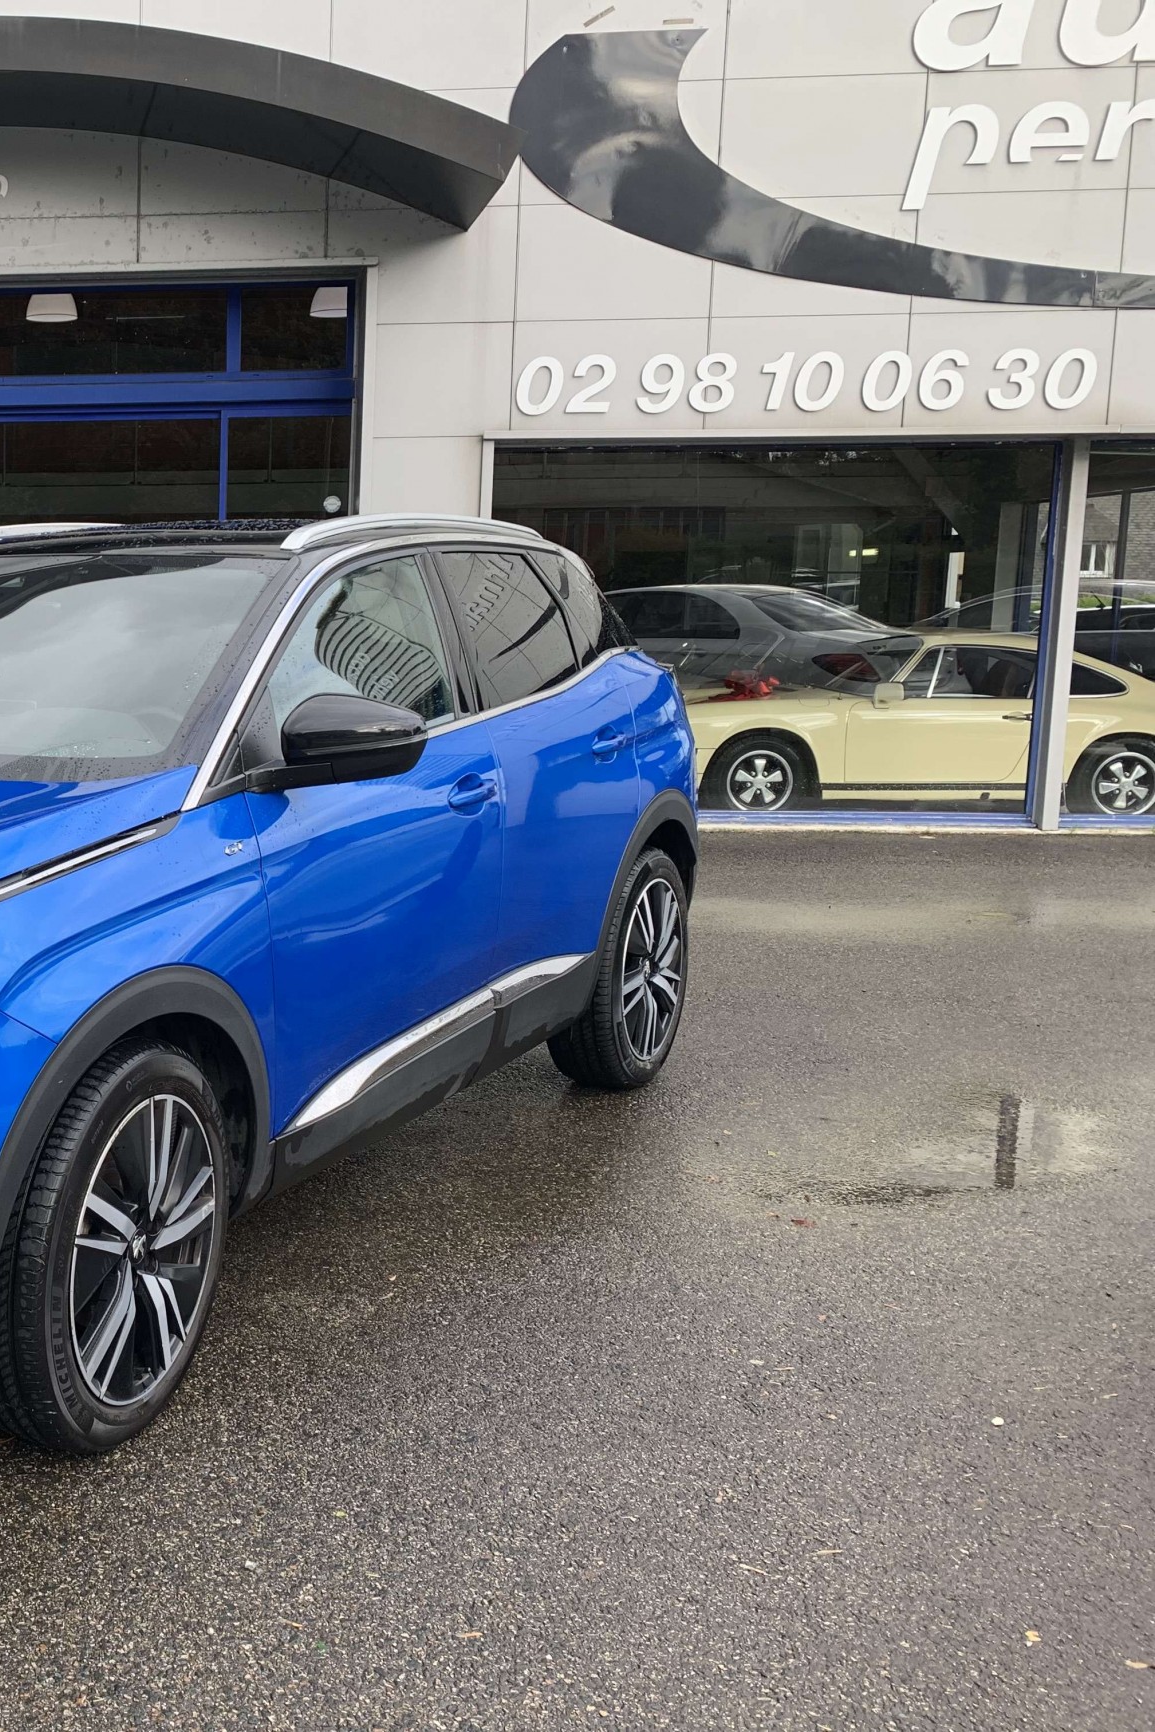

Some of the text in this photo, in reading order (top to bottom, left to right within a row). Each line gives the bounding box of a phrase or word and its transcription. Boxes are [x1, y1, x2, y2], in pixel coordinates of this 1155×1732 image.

[516, 347, 1098, 415] 02 98 10 06 30
